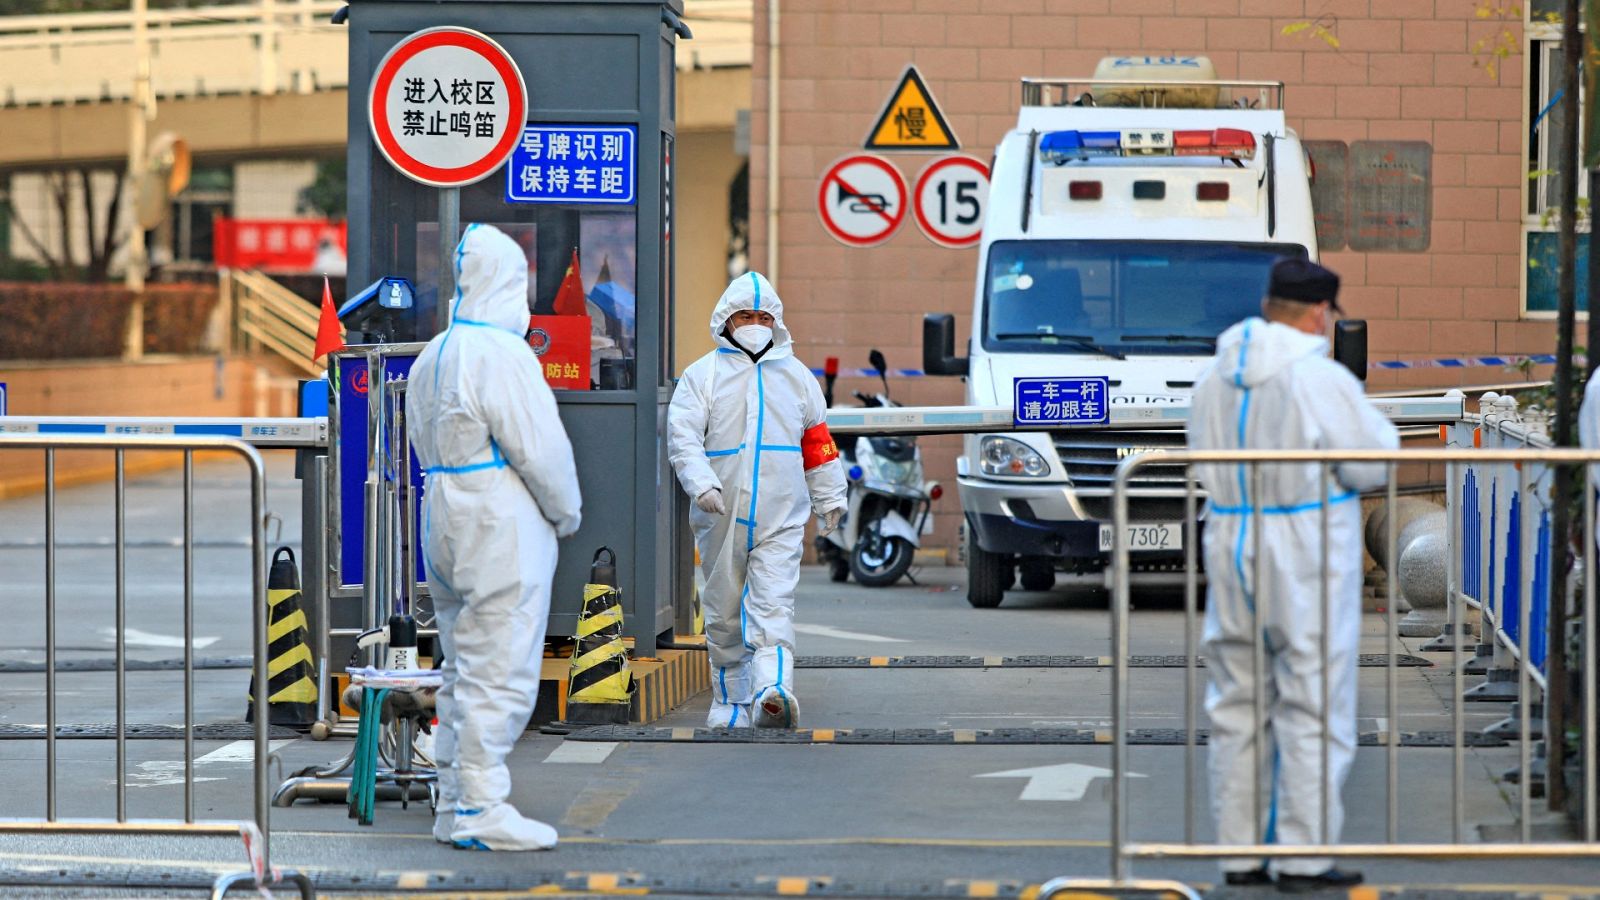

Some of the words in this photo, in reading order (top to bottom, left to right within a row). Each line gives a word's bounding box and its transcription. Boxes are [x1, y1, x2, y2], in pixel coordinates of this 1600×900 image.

[403, 78, 496, 106] 进入校区
[402, 109, 497, 139] 禁止鸣笛
[894, 107, 926, 141] 慢
[520, 132, 624, 162] 号牌识别
[1127, 132, 1165, 145] 警察
[519, 165, 624, 195] 保持车距
[937, 181, 980, 225] 15
[541, 363, 580, 379] 防站
[1023, 382, 1100, 400] 一车一杆
[1023, 401, 1100, 419] 请勿跟车
[1101, 527, 1169, 547] 陕7302
[395, 650, 408, 670] POLIC
